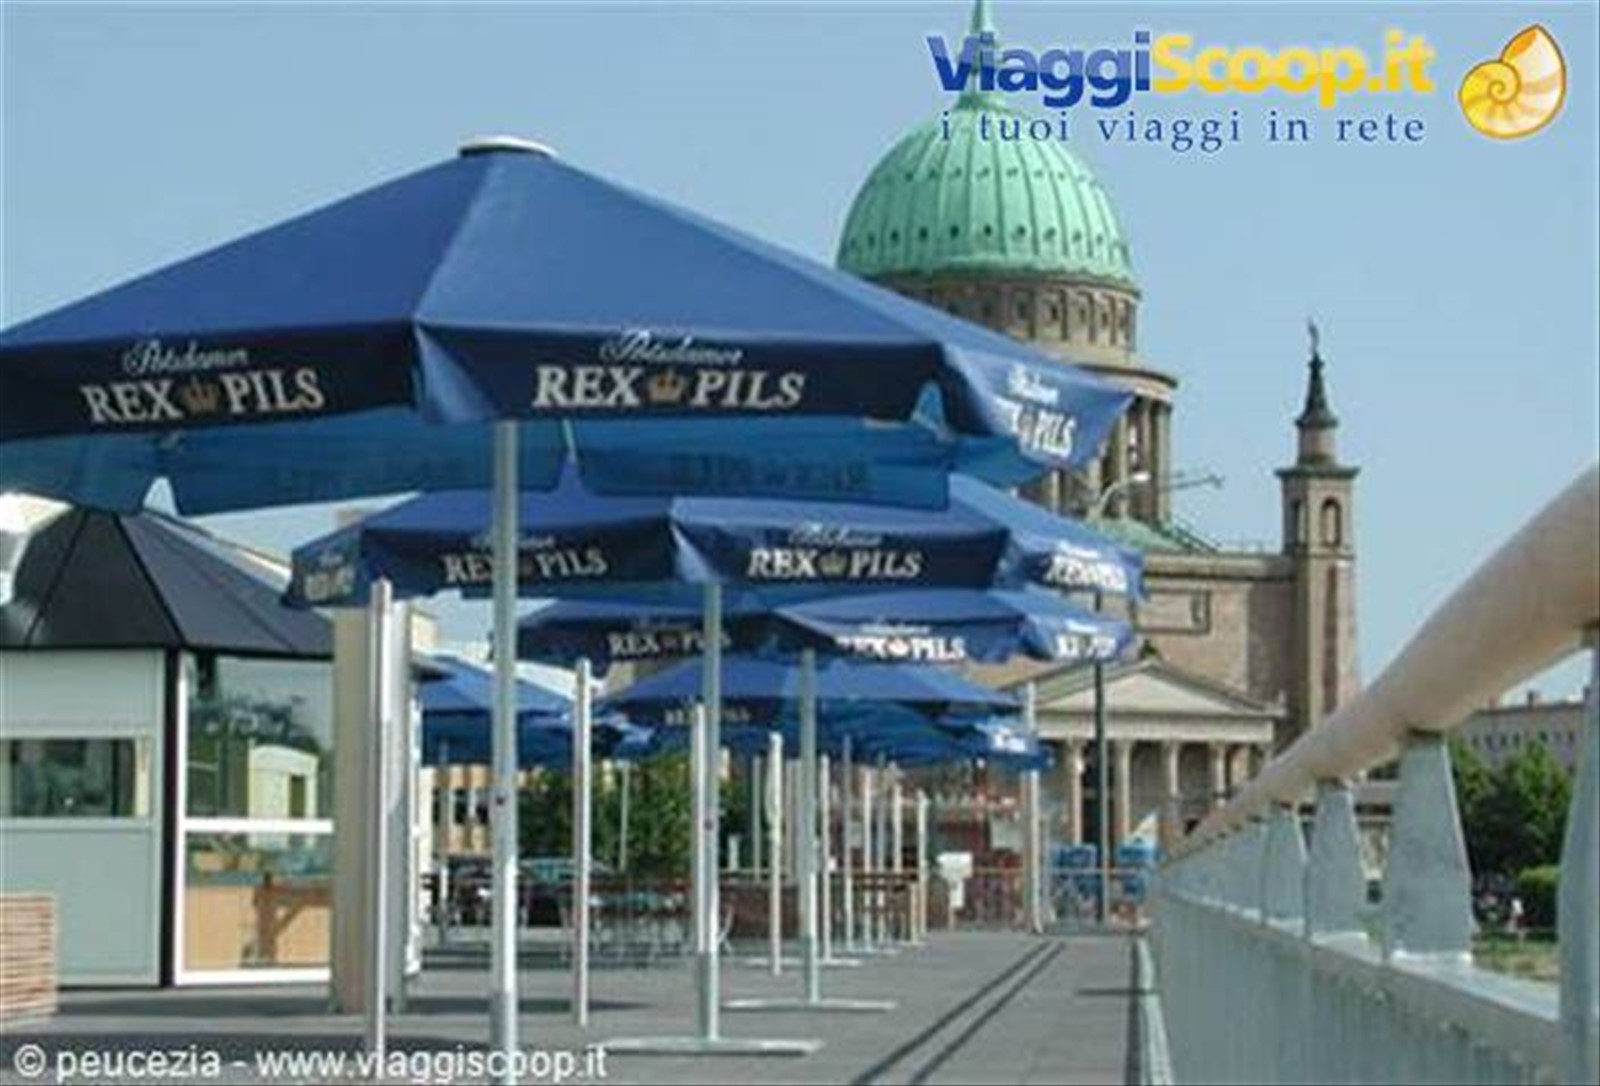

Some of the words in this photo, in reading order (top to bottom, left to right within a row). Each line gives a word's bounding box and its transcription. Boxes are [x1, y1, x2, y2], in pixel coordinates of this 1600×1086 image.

[79, 378, 184, 426] REX
[221, 367, 326, 416] PILS
[532, 365, 647, 409] REX
[690, 368, 807, 409] PILS
[534, 549, 608, 578] PILS
[747, 548, 819, 579] REX
[849, 549, 924, 578] PILS
